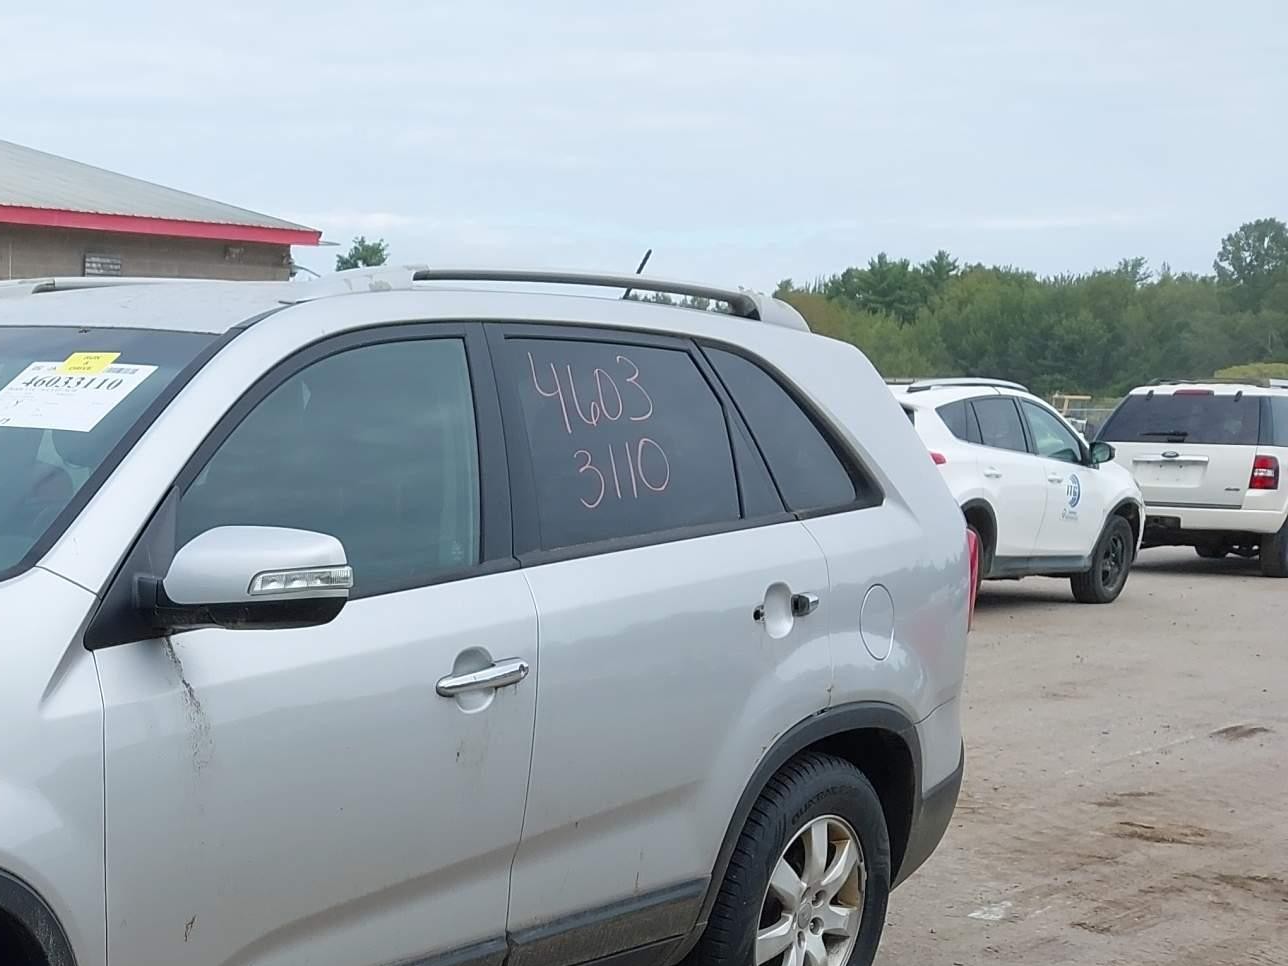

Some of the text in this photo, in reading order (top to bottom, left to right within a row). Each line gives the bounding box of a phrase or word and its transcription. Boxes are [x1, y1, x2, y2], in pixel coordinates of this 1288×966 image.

[22, 375, 124, 391] 46033110
[527, 351, 654, 434] 4603
[573, 437, 670, 509] 3110
